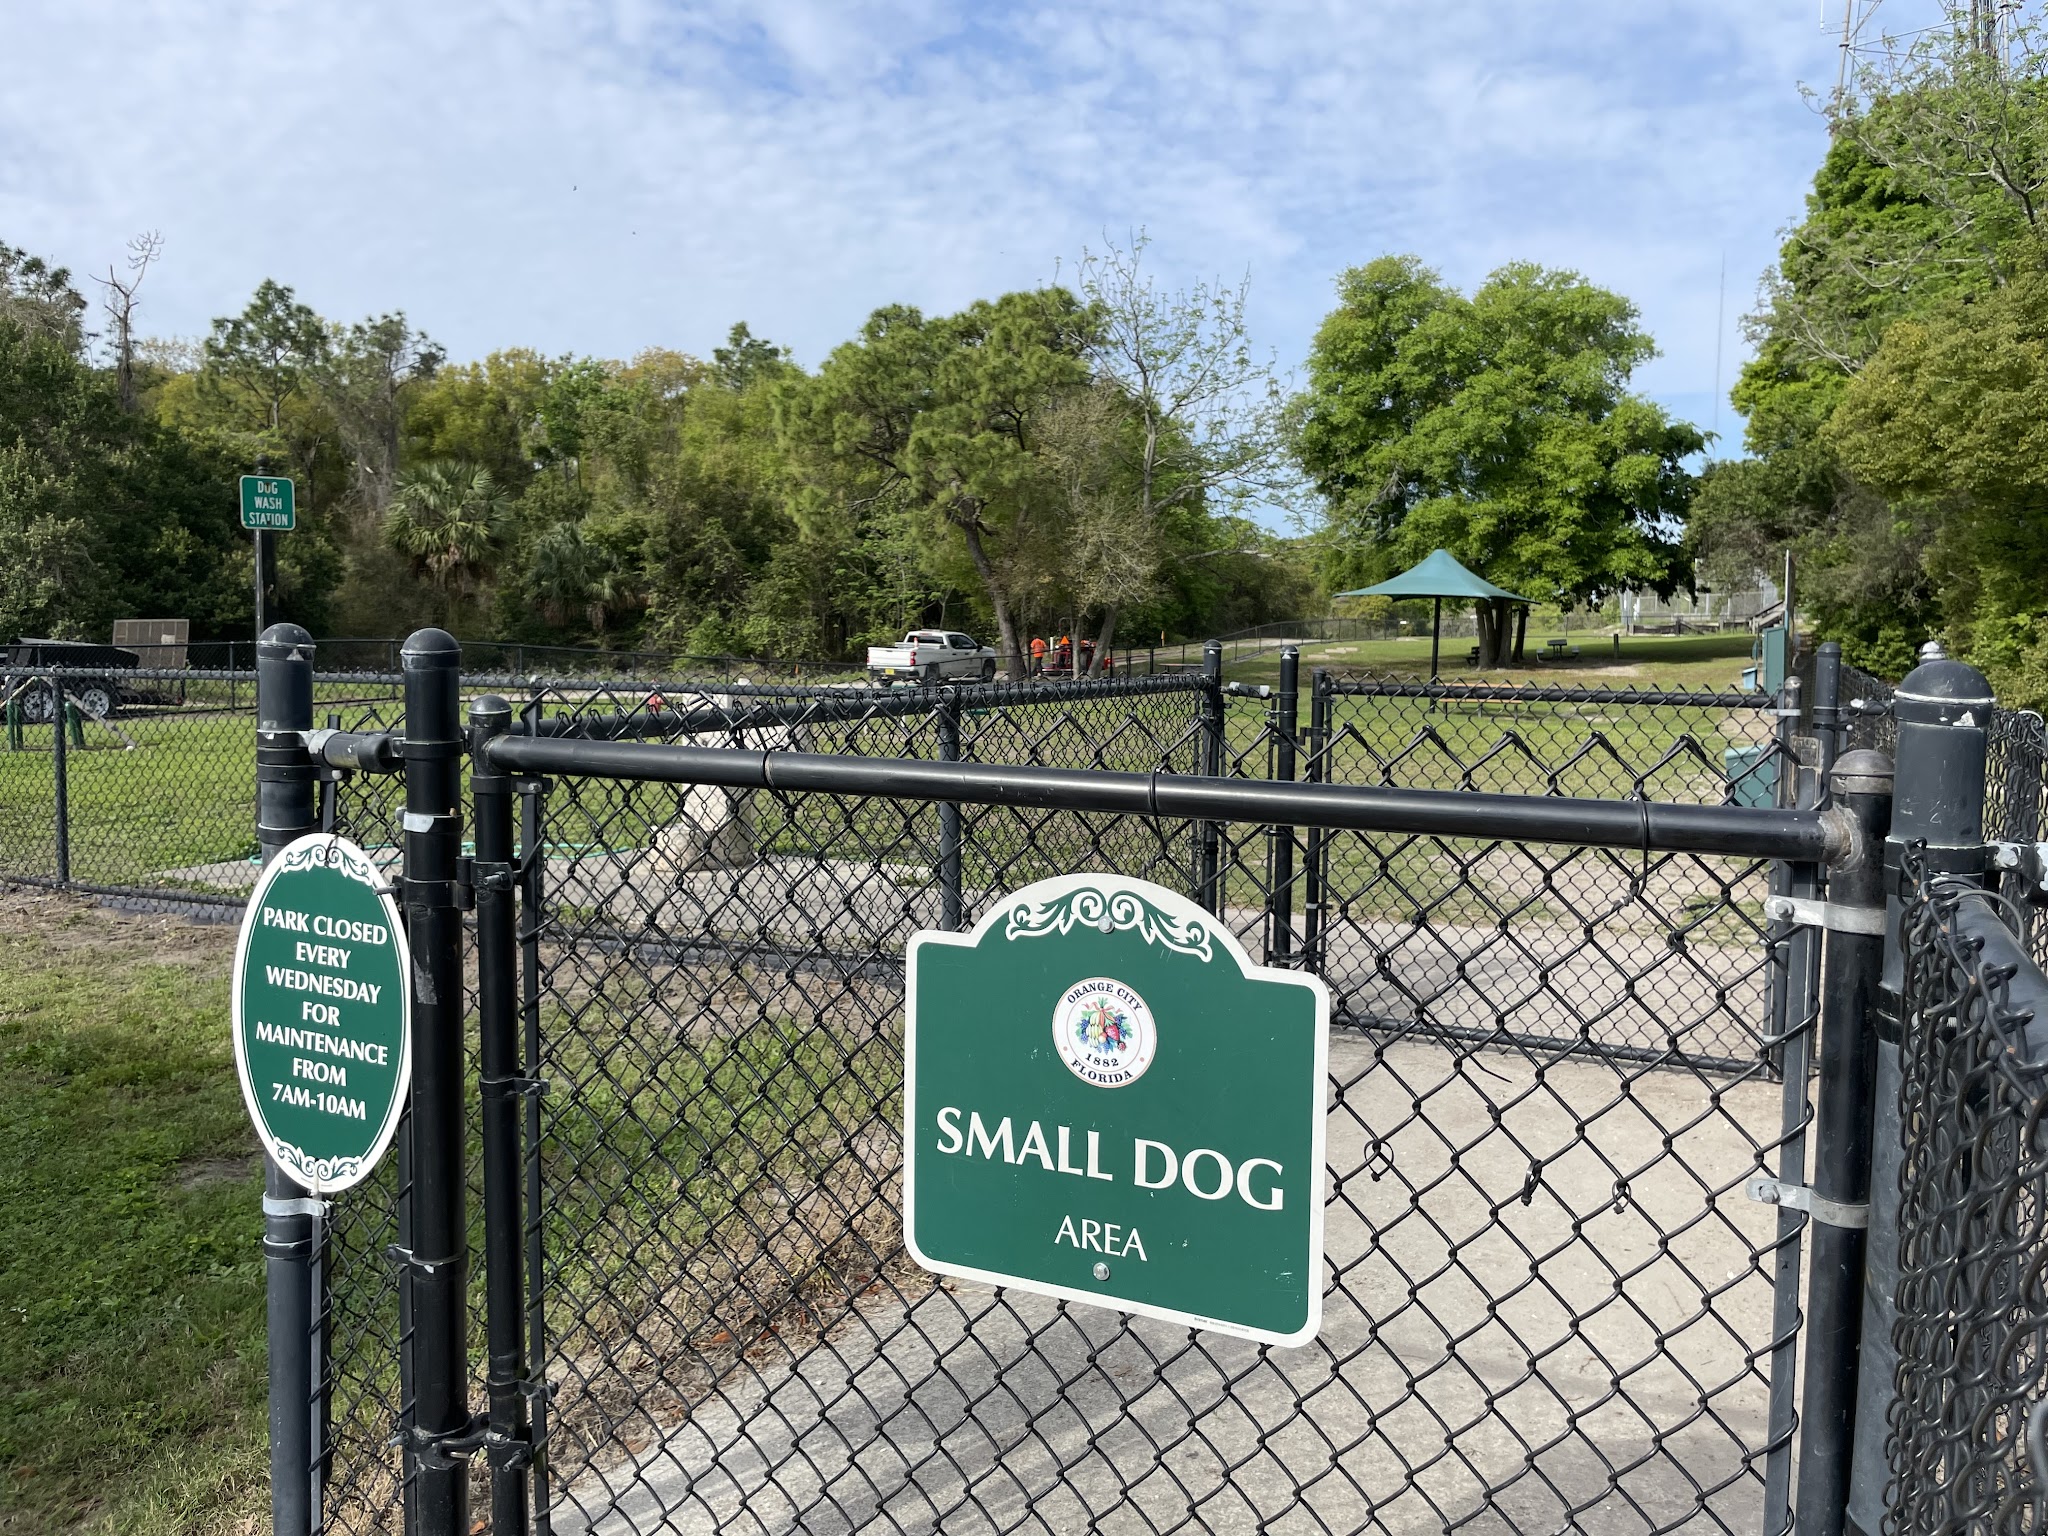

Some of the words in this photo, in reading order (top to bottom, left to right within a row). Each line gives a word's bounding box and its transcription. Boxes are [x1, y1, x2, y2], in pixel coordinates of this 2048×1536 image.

[254, 496, 283, 510] WASH
[249, 512, 288, 526] STATION
[263, 907, 310, 933] PARK
[313, 915, 388, 945] CLOSED
[295, 941, 352, 969] EVERY
[265, 965, 382, 1005] WEDNESDAY
[1067, 982, 1114, 1004] ORANGE
[1116, 987, 1142, 1012] CITY
[302, 1001, 341, 1027] FOR
[255, 1021, 389, 1066] MAINTENANCE
[292, 1057, 347, 1087] FROM
[1070, 1058, 1134, 1083] FLORIDA
[1085, 1053, 1119, 1068] 1882
[272, 1083, 367, 1121] 7AM-10AM
[936, 1107, 1113, 1181] SMALL
[1133, 1137, 1284, 1211] DOG
[1054, 1215, 1148, 1262] AREA
